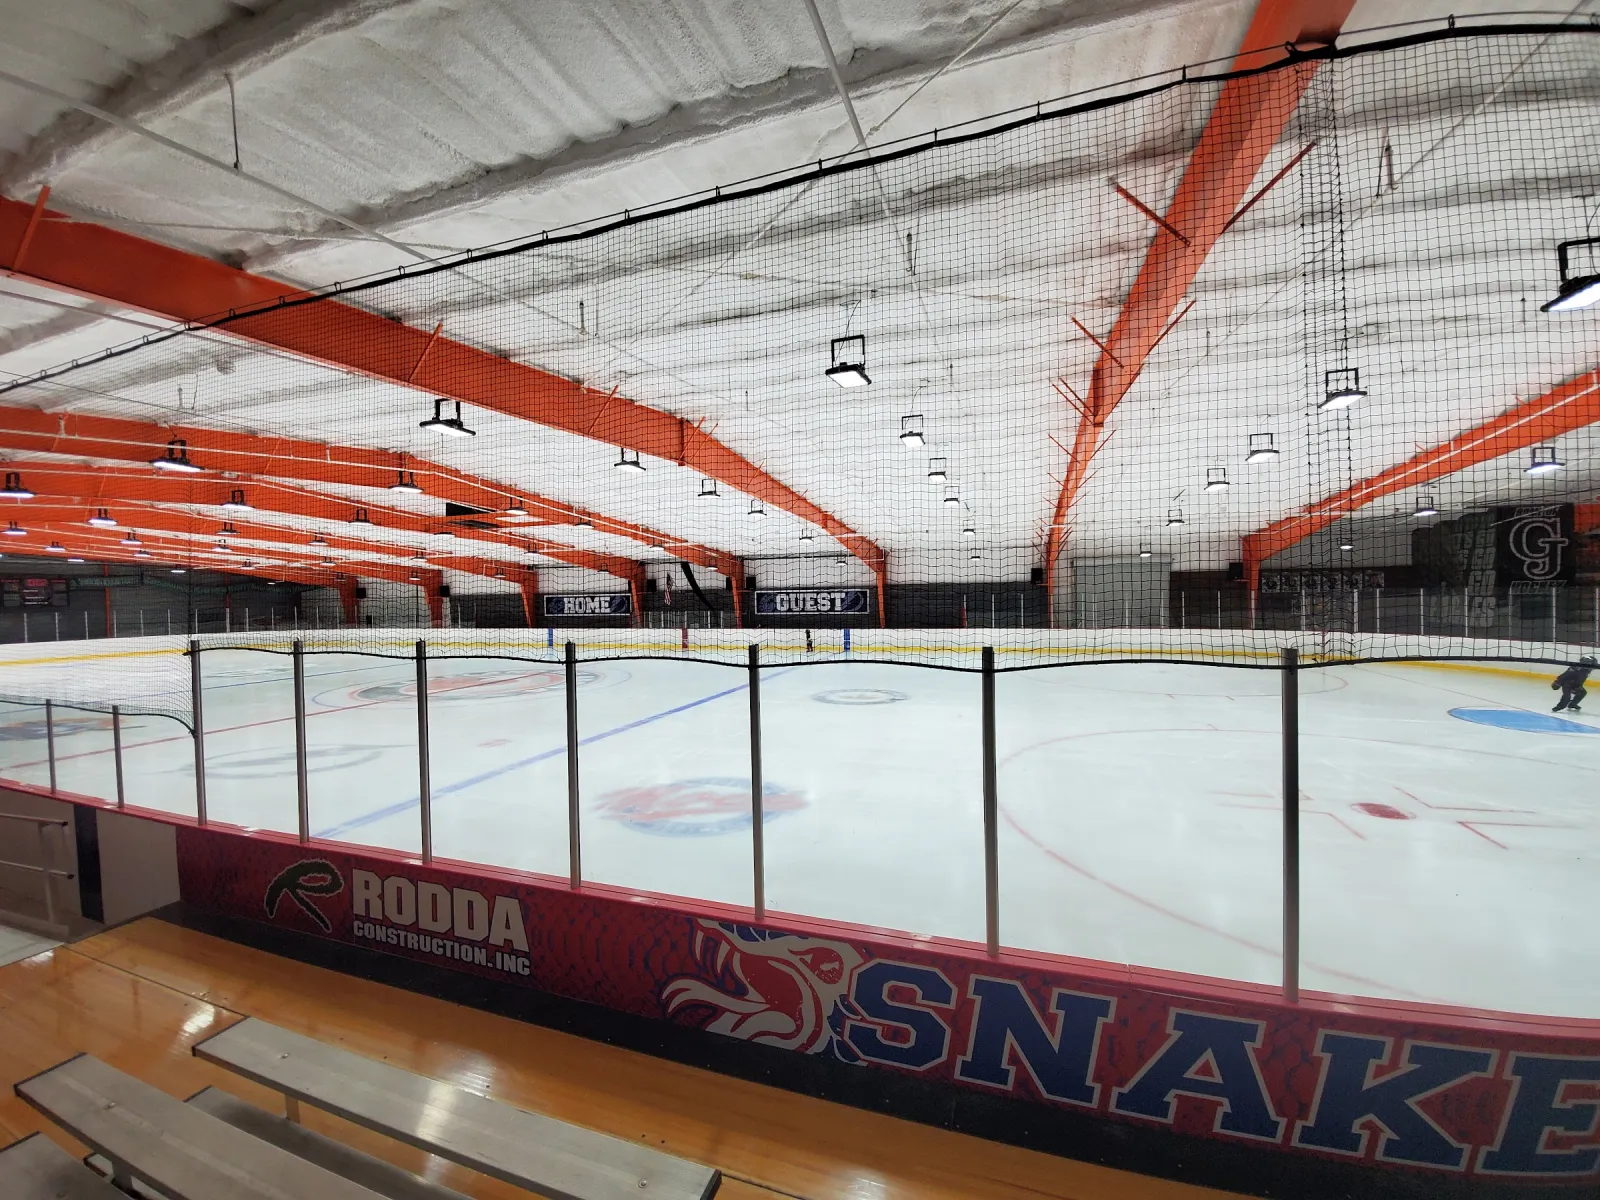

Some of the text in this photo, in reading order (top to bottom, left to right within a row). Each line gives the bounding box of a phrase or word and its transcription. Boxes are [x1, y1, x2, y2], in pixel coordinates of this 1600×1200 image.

[563, 594, 610, 614] HOME
[775, 590, 845, 612] GUEST
[352, 868, 531, 952] RODDA
[844, 958, 1600, 1176] SNAKE
